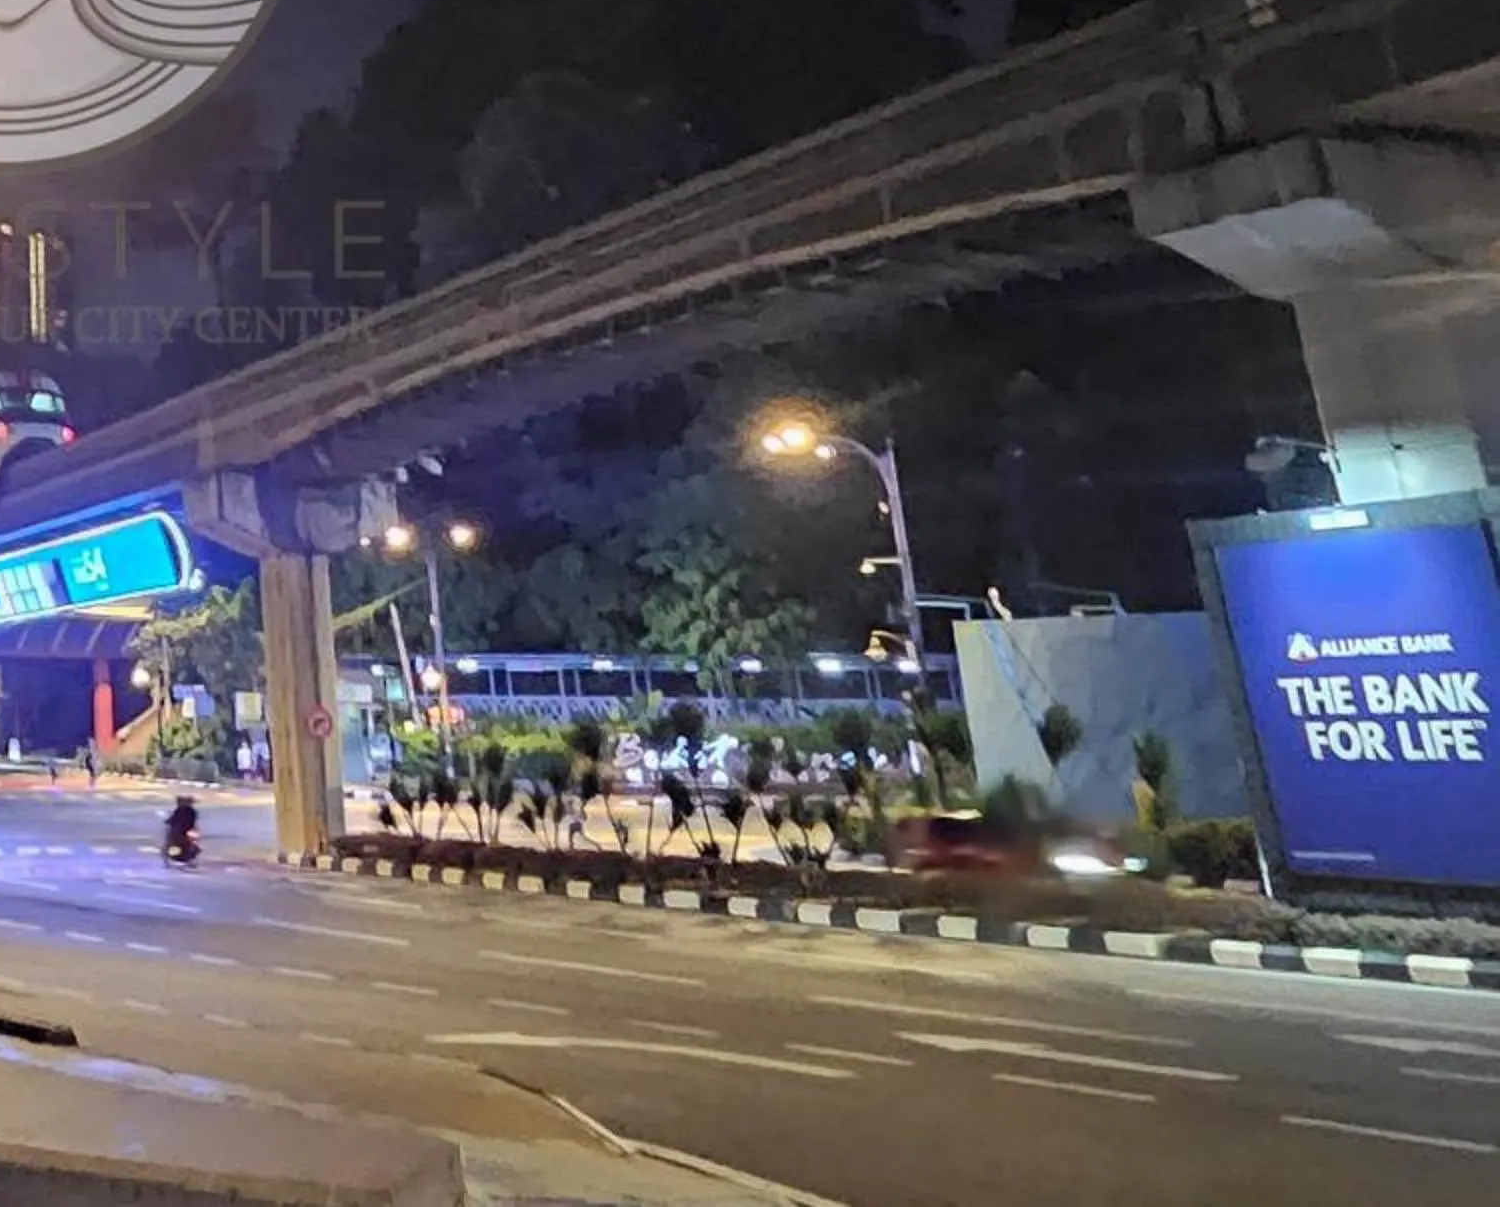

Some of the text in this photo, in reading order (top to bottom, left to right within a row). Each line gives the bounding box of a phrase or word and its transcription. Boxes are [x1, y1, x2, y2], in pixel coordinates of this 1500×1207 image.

[1320, 633, 1454, 658] ALLIANCE BANK
[1277, 672, 1490, 716] THE BANK
[1304, 720, 1394, 761] FOR
